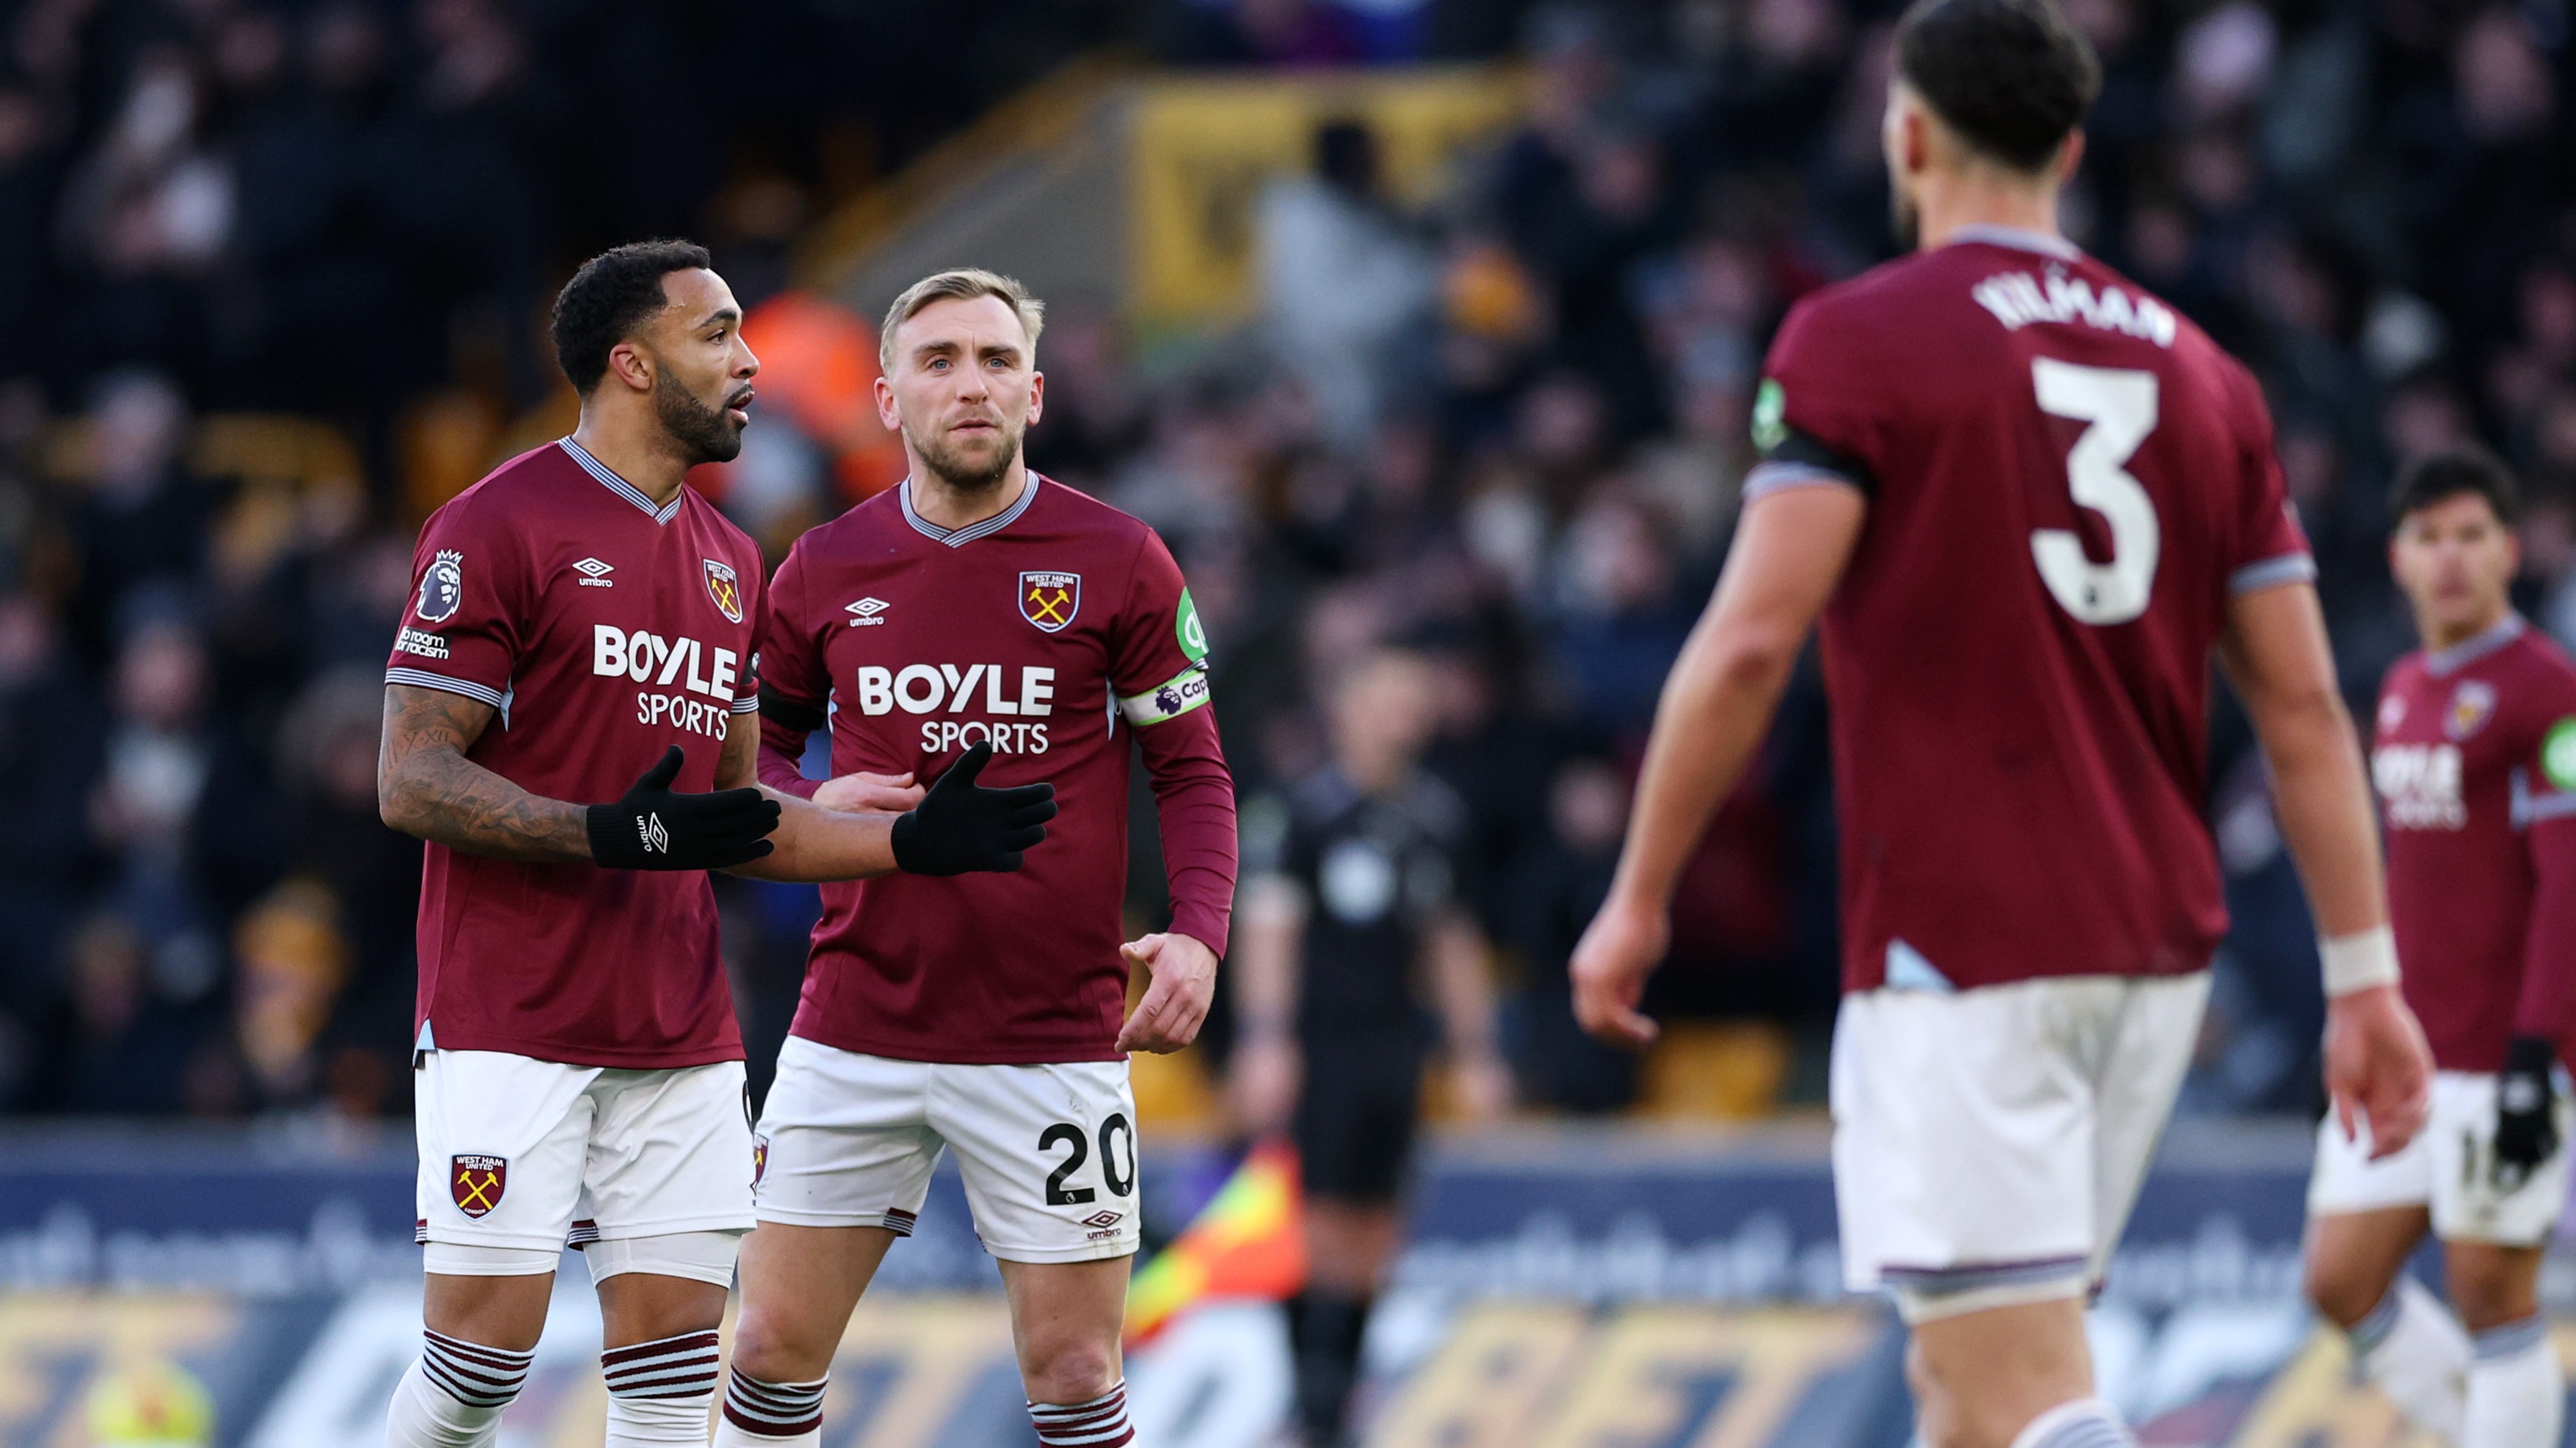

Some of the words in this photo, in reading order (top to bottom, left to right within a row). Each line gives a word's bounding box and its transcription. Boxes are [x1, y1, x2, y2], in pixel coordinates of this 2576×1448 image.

[2031, 355, 2161, 626] 3
[579, 577, 613, 588] umbro
[1052, 575, 1074, 584] HAM
[849, 616, 884, 628] umbro
[406, 641, 450, 659] racism
[410, 631, 445, 648] room
[593, 624, 737, 702] BOYLE
[858, 663, 1055, 716] BOYLE
[637, 691, 730, 742] SPORTS
[920, 720, 1049, 754] SPORTS
[636, 815, 652, 852] umbro
[482, 1157, 504, 1167] HAM
[1038, 1112, 1135, 1206] 20
[1087, 1227, 1122, 1240] umbro
